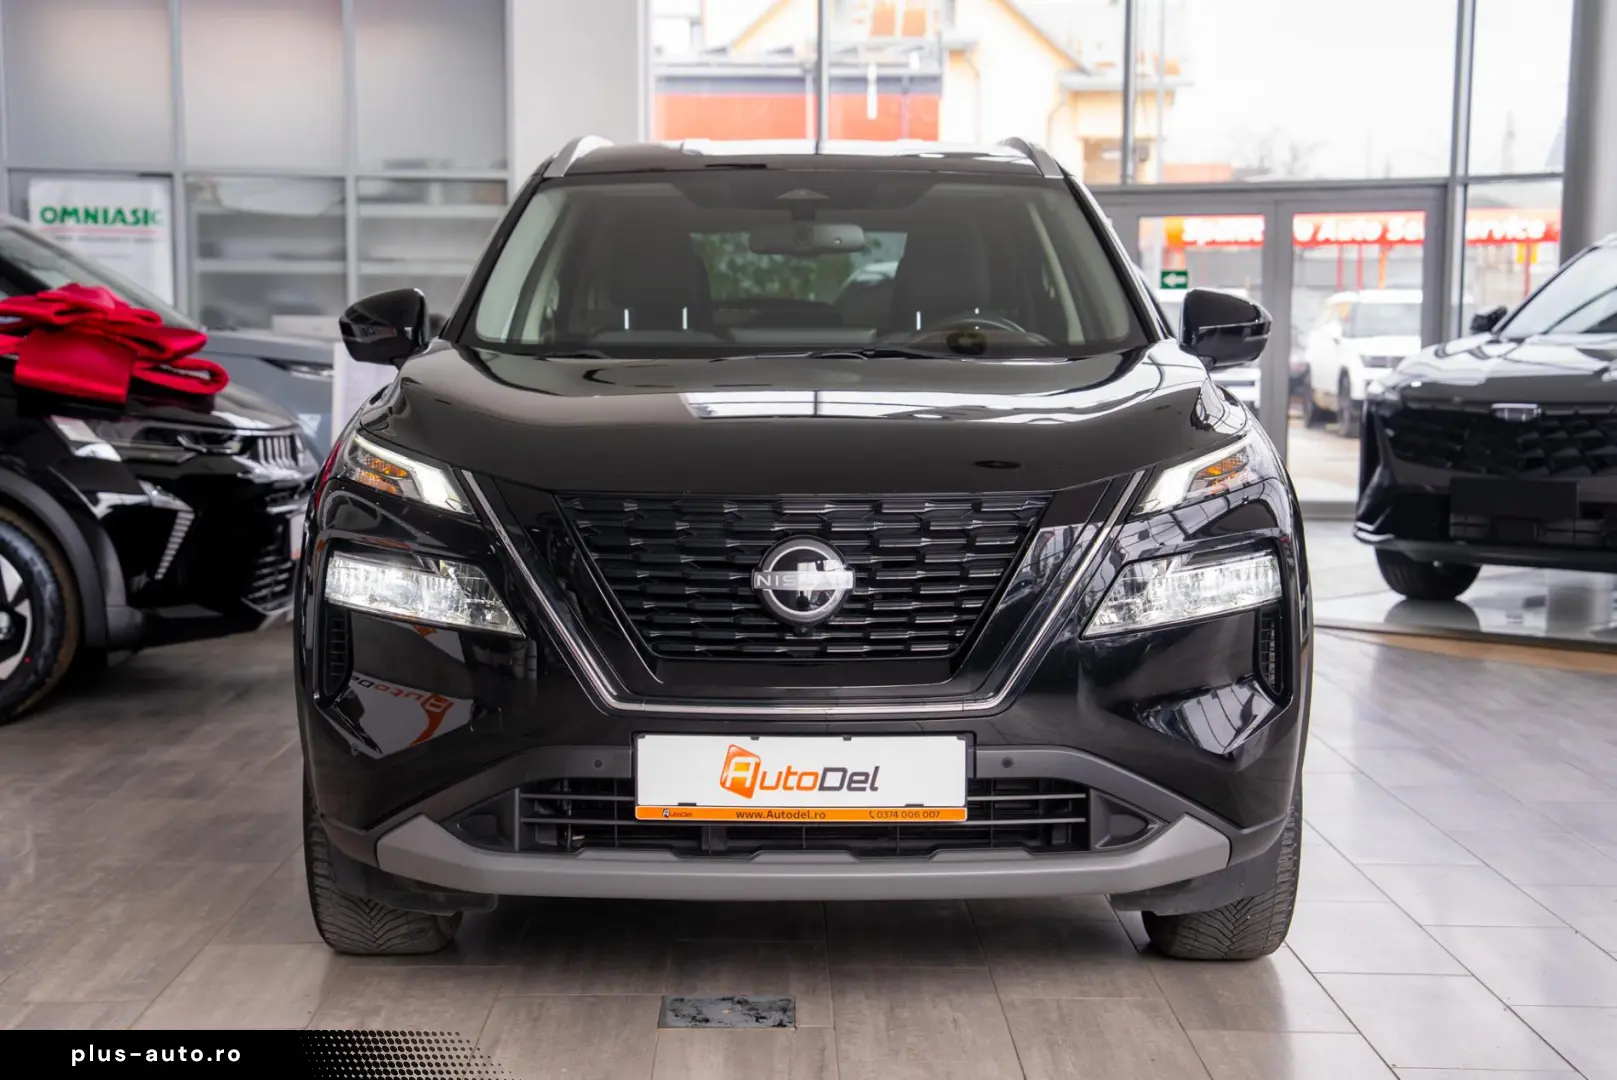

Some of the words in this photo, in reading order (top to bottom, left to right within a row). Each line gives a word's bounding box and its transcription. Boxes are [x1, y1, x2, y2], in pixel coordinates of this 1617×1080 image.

[720, 748, 880, 796] AutoDel
[736, 809, 827, 821] www.Autodel.ro
[876, 810, 899, 819] 0374
[901, 810, 921, 819] 006
[922, 810, 941, 819] 007
